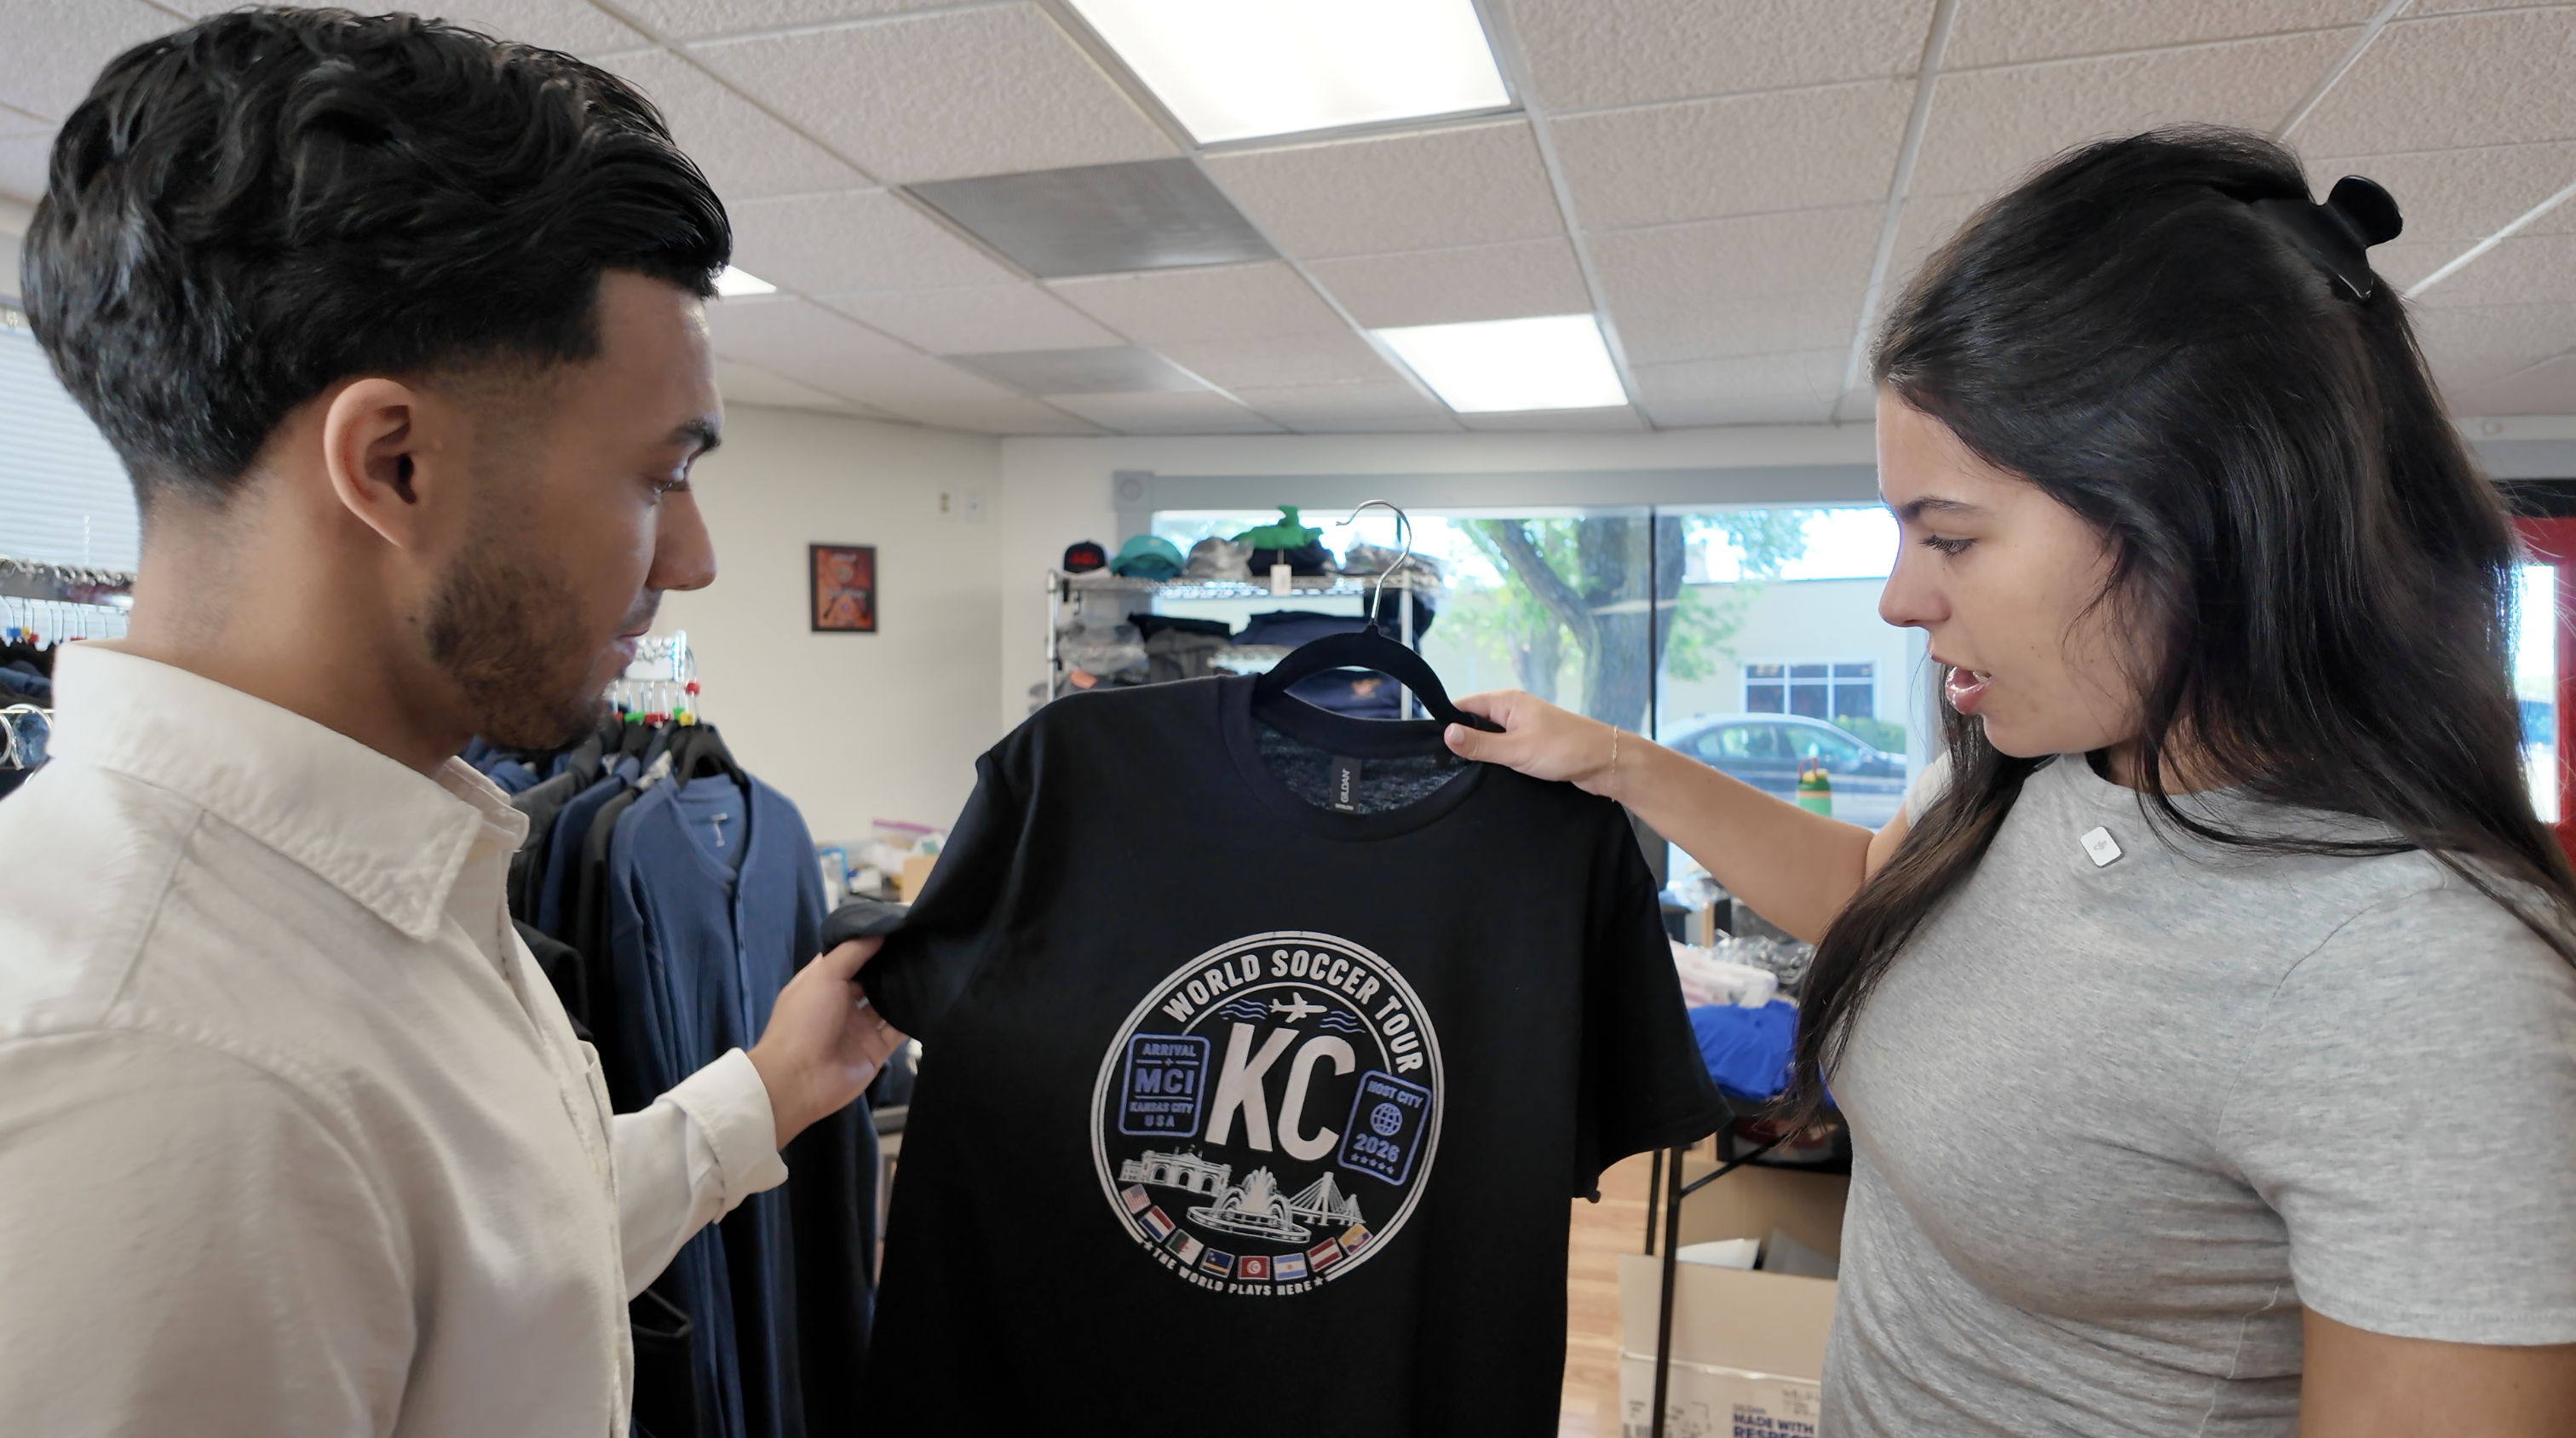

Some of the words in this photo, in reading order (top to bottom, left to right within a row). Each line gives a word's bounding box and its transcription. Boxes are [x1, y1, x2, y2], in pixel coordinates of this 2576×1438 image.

[1162, 954, 1261, 1023] WORLD
[1271, 949, 1380, 1005] SOCCER
[1374, 995, 1423, 1073] TOUR
[1141, 1043, 1197, 1057] ARRIVAL
[1134, 1067, 1195, 1094] MCI
[1204, 1022, 1356, 1161] KC
[1366, 1080, 1398, 1099] HOST
[1396, 1090, 1423, 1108] CITY
[1129, 1102, 1170, 1113] KANSAS
[1170, 1102, 1194, 1113] CITY
[1144, 1114, 1176, 1127] USA
[1353, 1133, 1400, 1162] 2026
[1152, 1247, 1177, 1270] THE
[1178, 1266, 1225, 1291] WORLD
[1228, 1283, 1272, 1296] PLAYS
[1276, 1280, 1313, 1296] HERE
[1734, 1414, 1773, 1429] MADE
[1777, 1419, 1814, 1435] WITH
